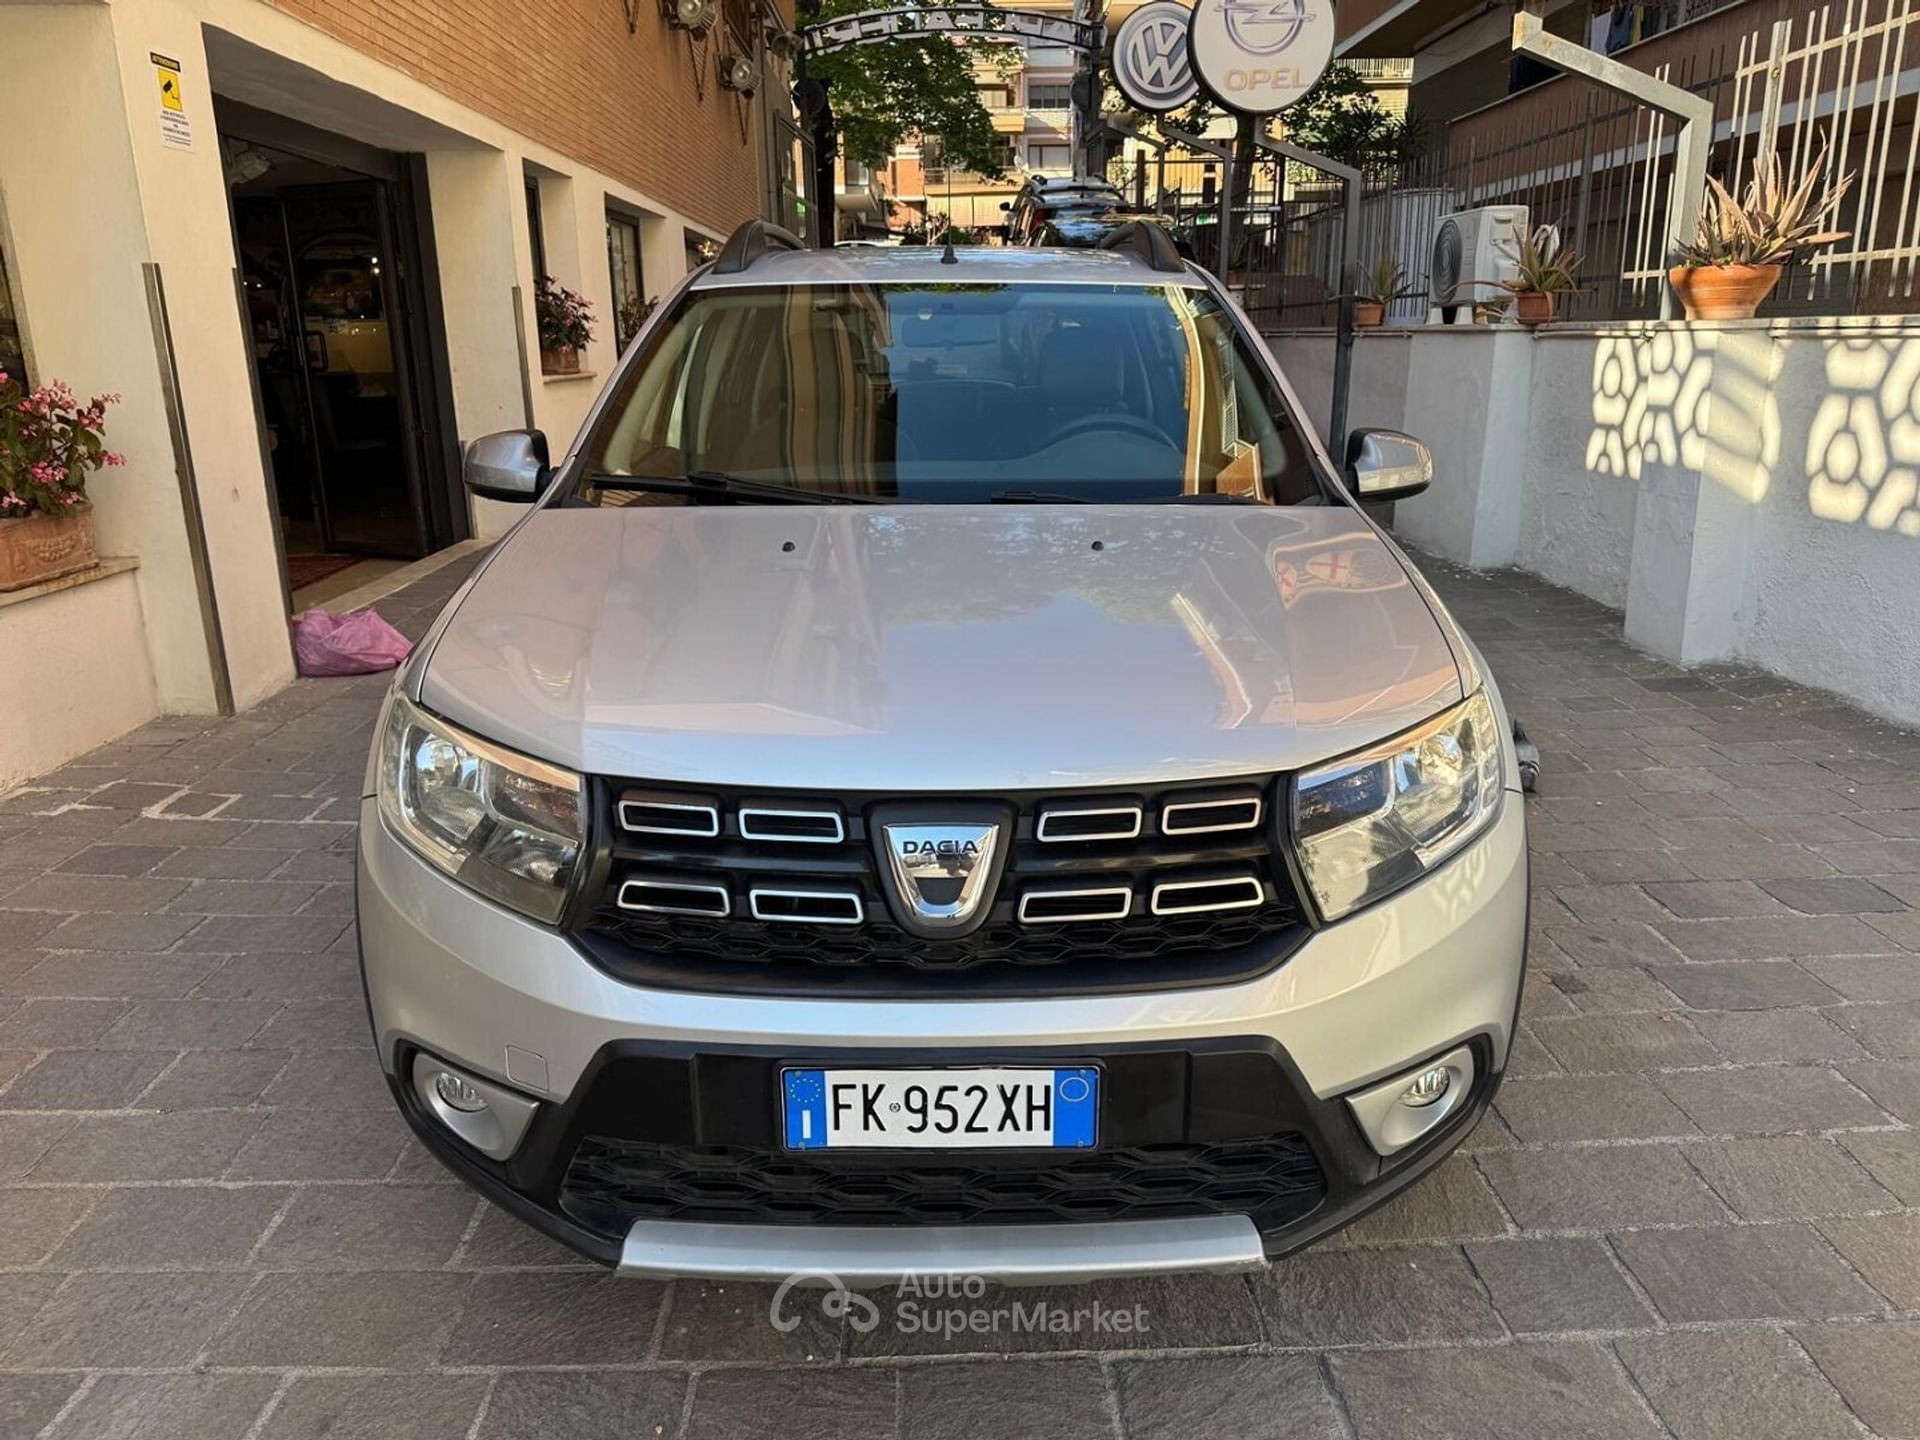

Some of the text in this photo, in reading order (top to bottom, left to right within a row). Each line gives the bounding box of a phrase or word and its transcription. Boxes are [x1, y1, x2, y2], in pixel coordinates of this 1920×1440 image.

[1223, 66, 1310, 92] OPEL
[902, 840, 979, 854] DACIA
[832, 1083, 887, 1132] FK
[904, 1083, 1051, 1133] 952XH
